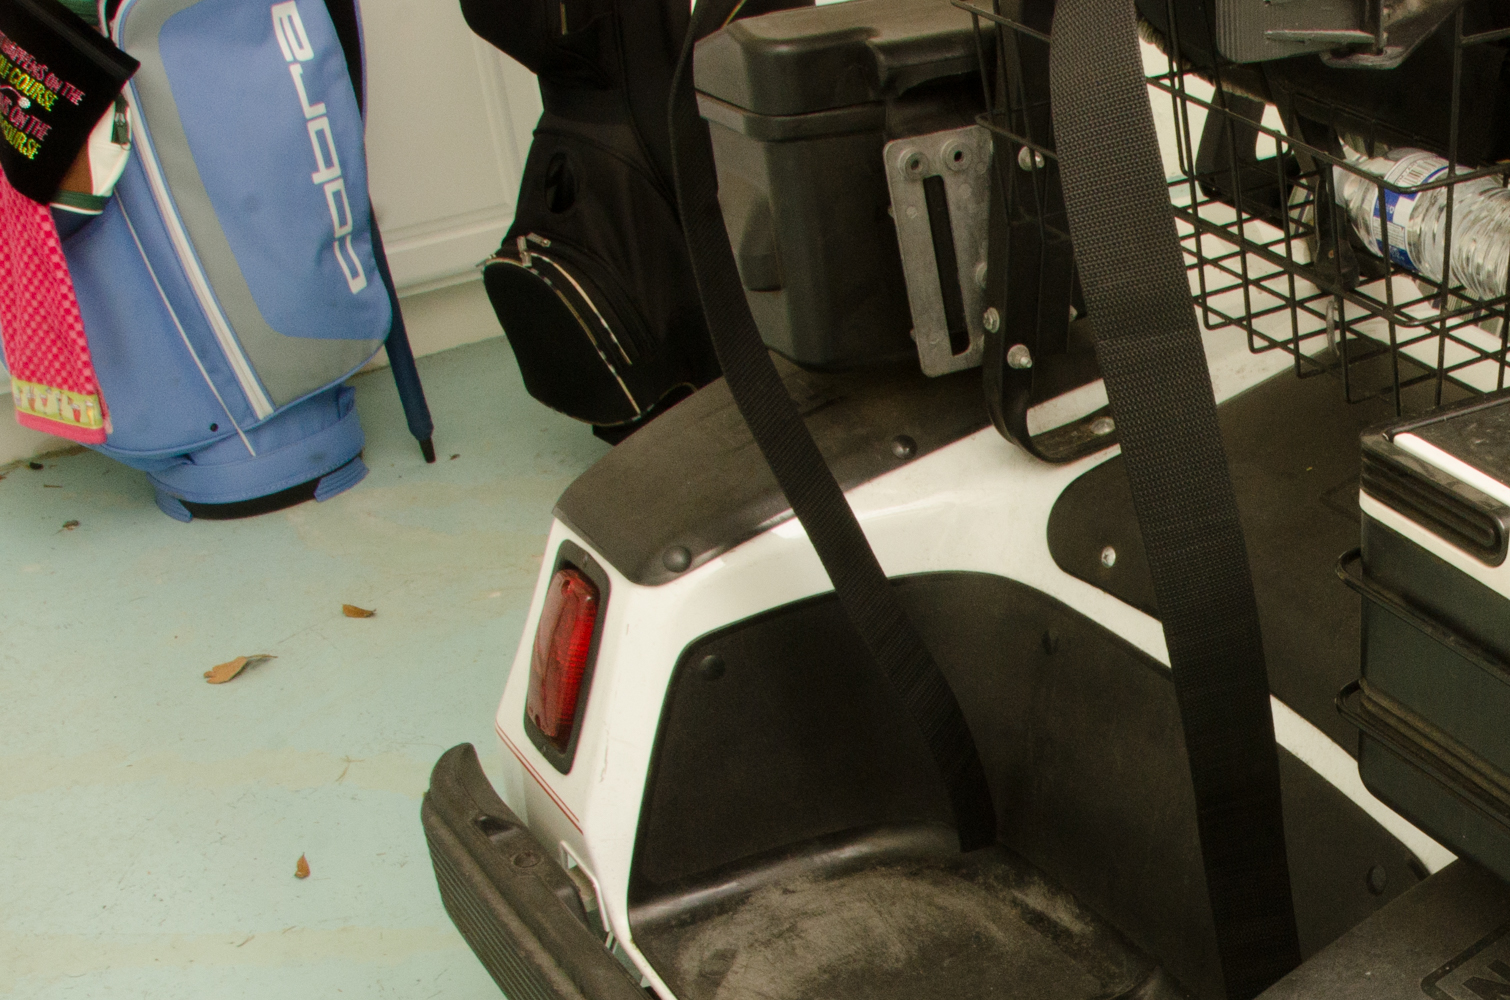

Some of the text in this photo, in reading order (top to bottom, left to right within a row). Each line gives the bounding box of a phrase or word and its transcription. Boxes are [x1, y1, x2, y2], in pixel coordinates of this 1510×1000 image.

[9, 67, 58, 112] COURSE
[45, 72, 63, 93] ON
[61, 81, 86, 106] THE
[9, 106, 30, 130] ON
[25, 115, 52, 141] THE
[271, 1, 368, 294] cobra
